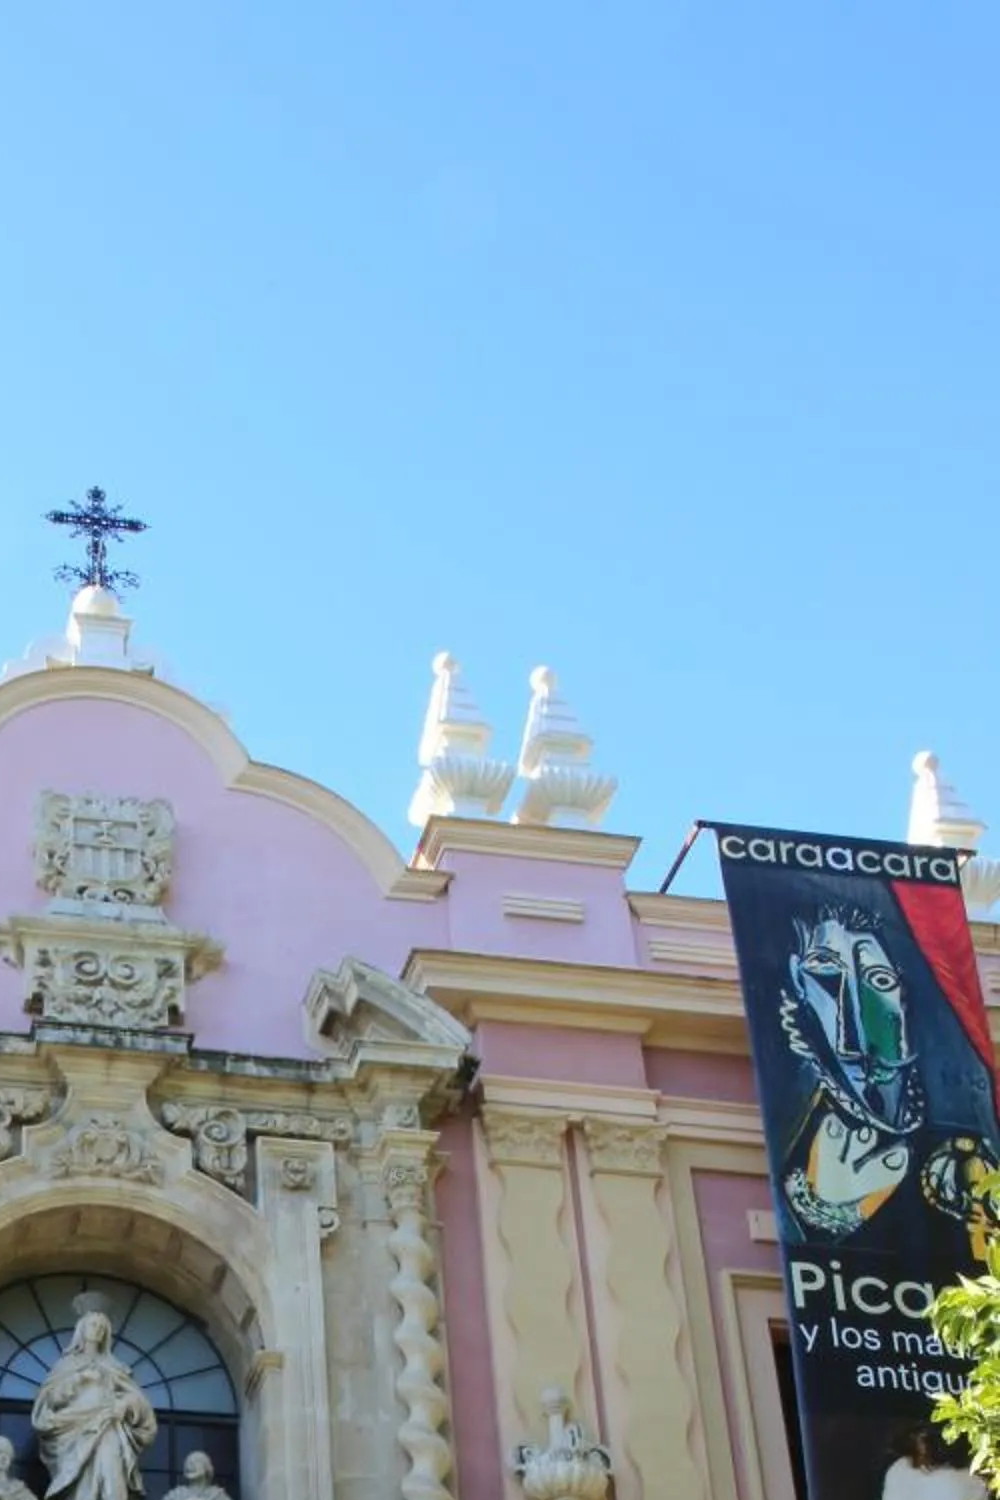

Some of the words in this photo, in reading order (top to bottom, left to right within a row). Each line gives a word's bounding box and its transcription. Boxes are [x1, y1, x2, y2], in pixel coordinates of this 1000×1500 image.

[720, 835, 957, 882] caraacara
[792, 1261, 937, 1318] Pica
[800, 1325, 818, 1352] y
[831, 1318, 881, 1350] los
